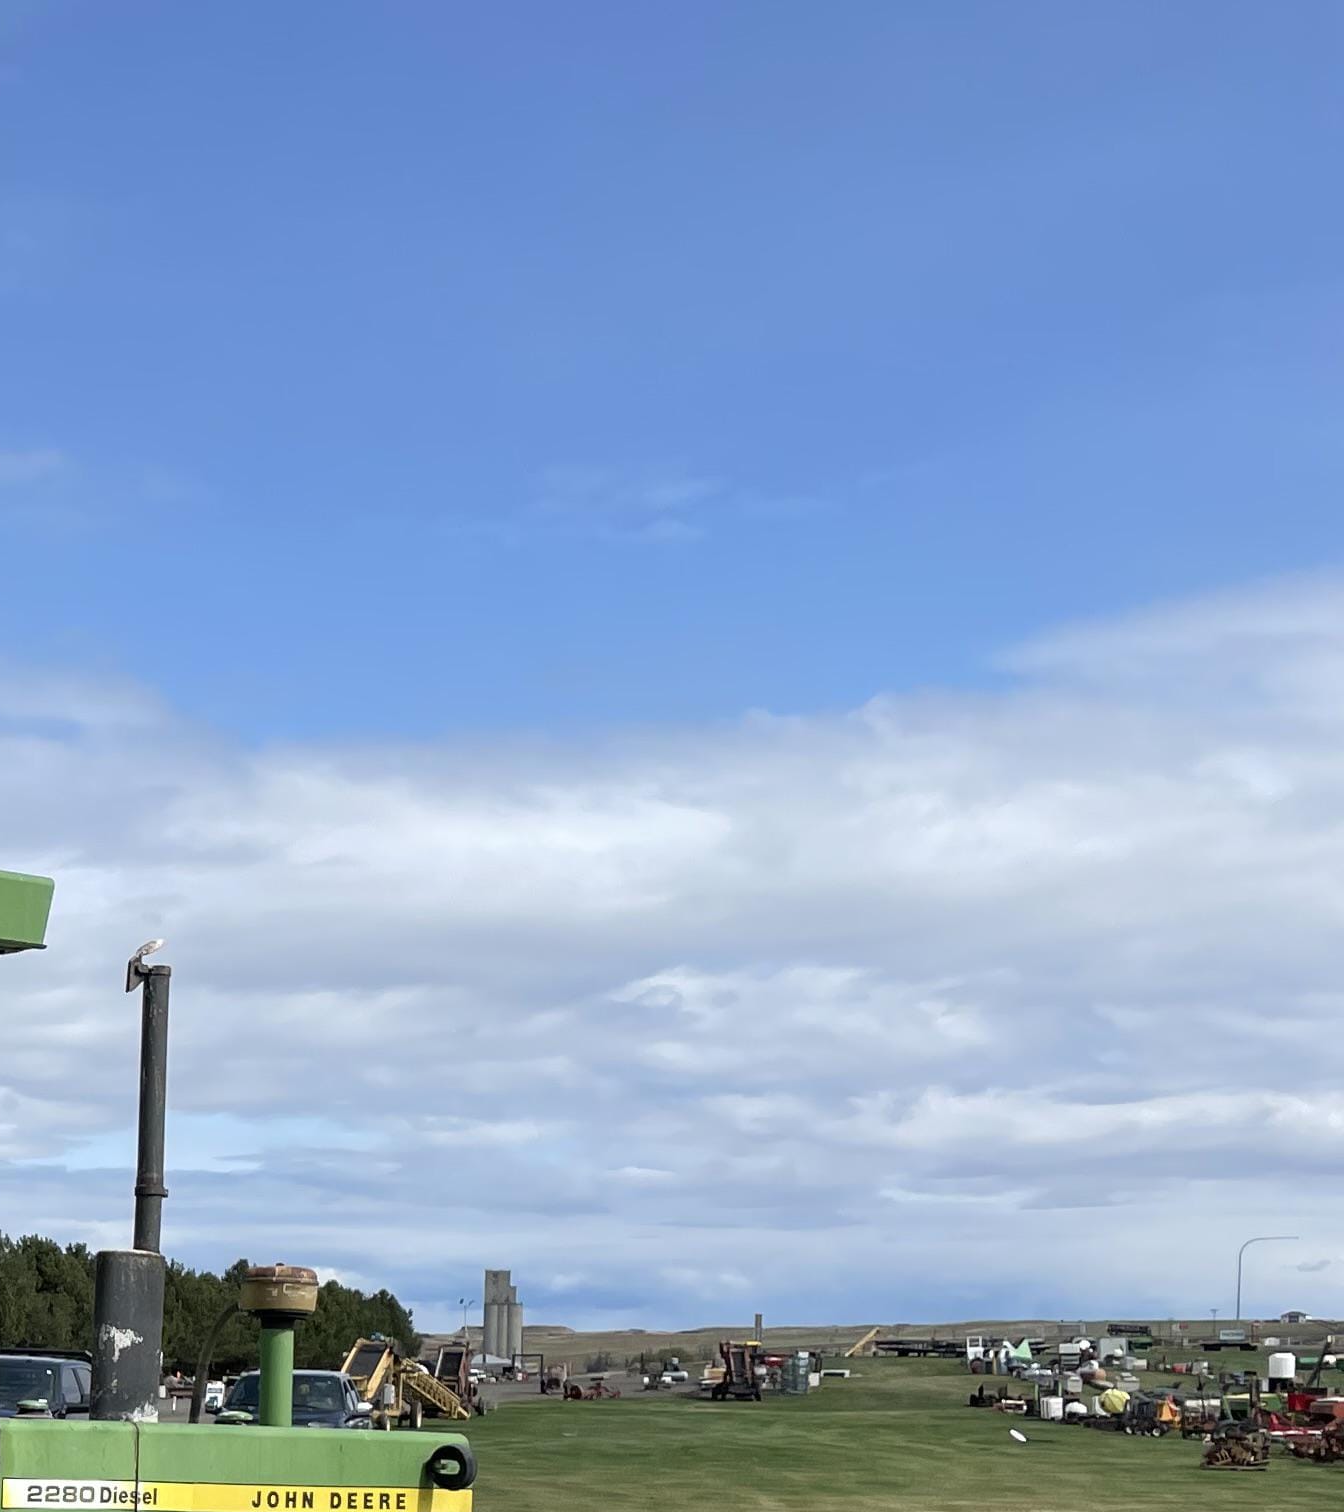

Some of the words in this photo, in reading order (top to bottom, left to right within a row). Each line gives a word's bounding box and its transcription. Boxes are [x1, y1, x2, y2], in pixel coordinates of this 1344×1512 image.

[26, 1485, 95, 1503] 2280
[99, 1486, 158, 1506] Diesel
[251, 1490, 314, 1509] JOHN
[329, 1491, 407, 1510] DEERE
